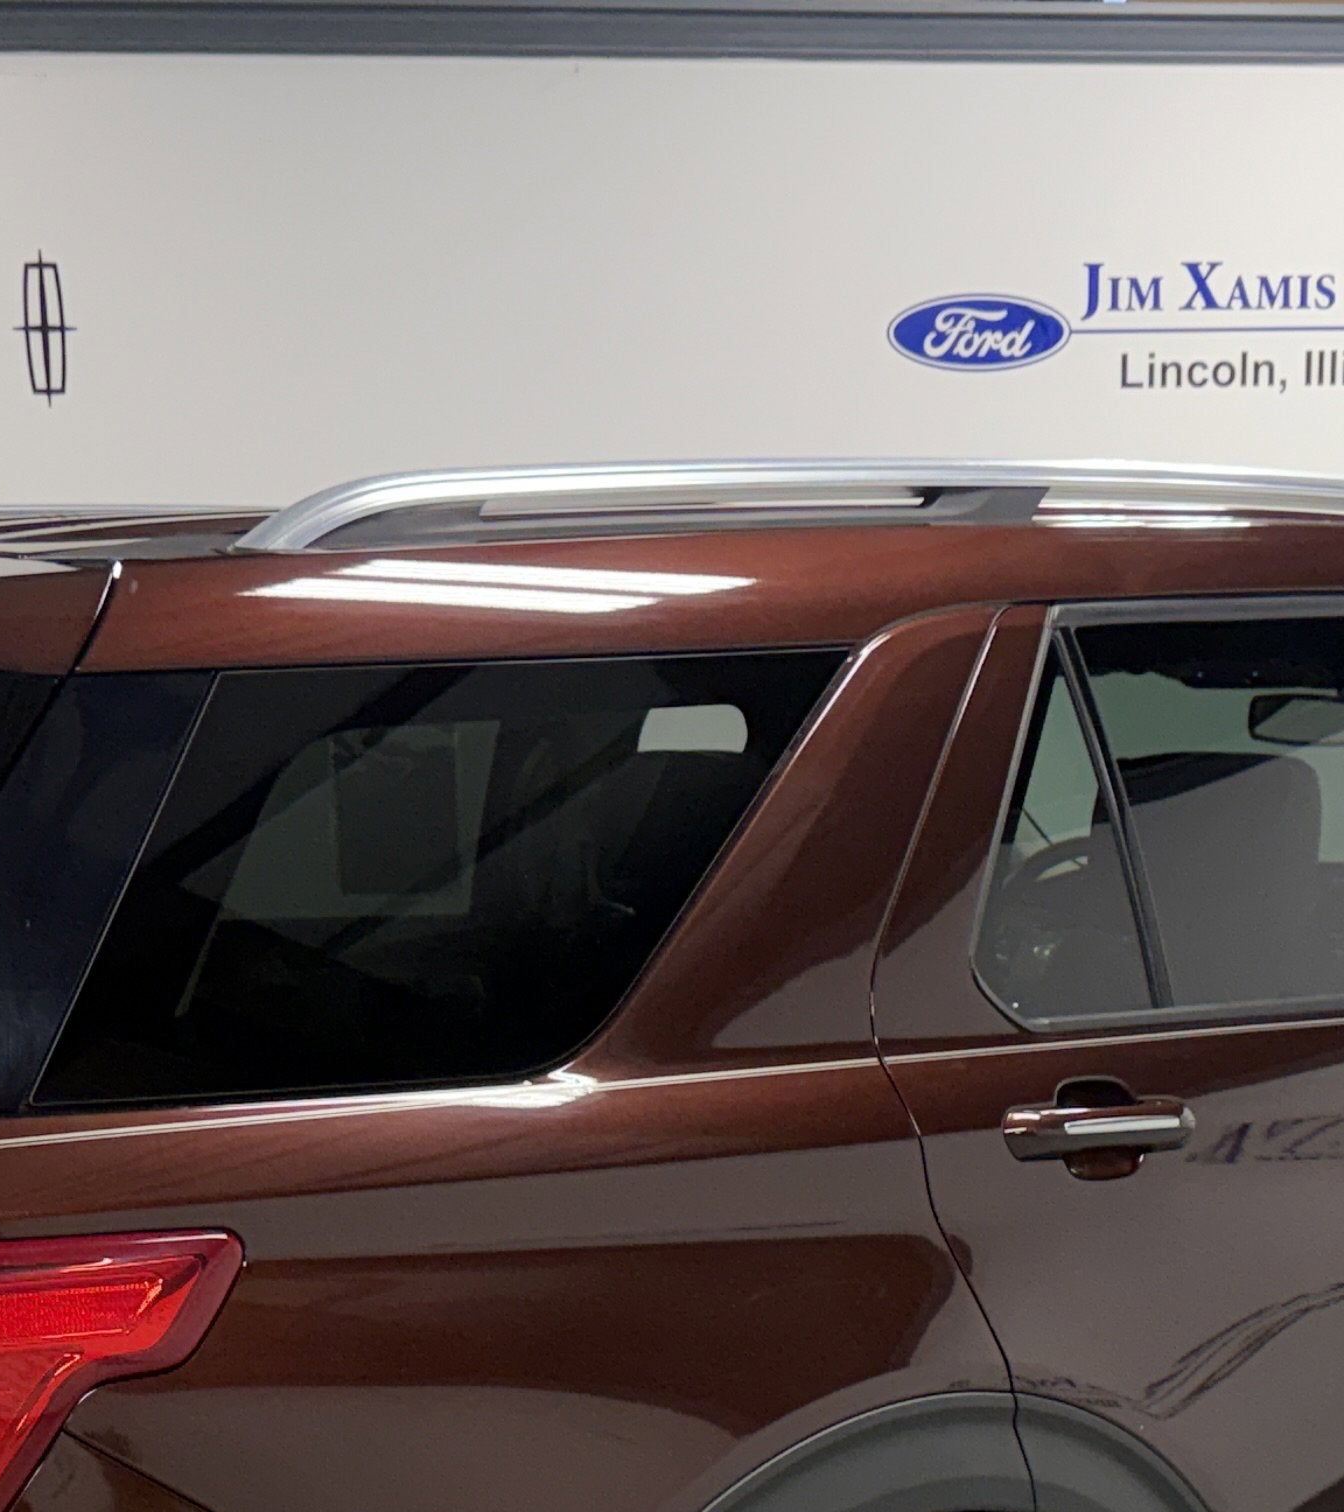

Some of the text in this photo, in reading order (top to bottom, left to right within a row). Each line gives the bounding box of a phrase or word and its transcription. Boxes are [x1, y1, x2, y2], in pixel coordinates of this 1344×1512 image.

[1080, 262, 1164, 320] JIM
[1178, 261, 1336, 312] XAMIS
[922, 307, 1036, 358] Ford
[1120, 350, 1287, 394] Lincoln,
